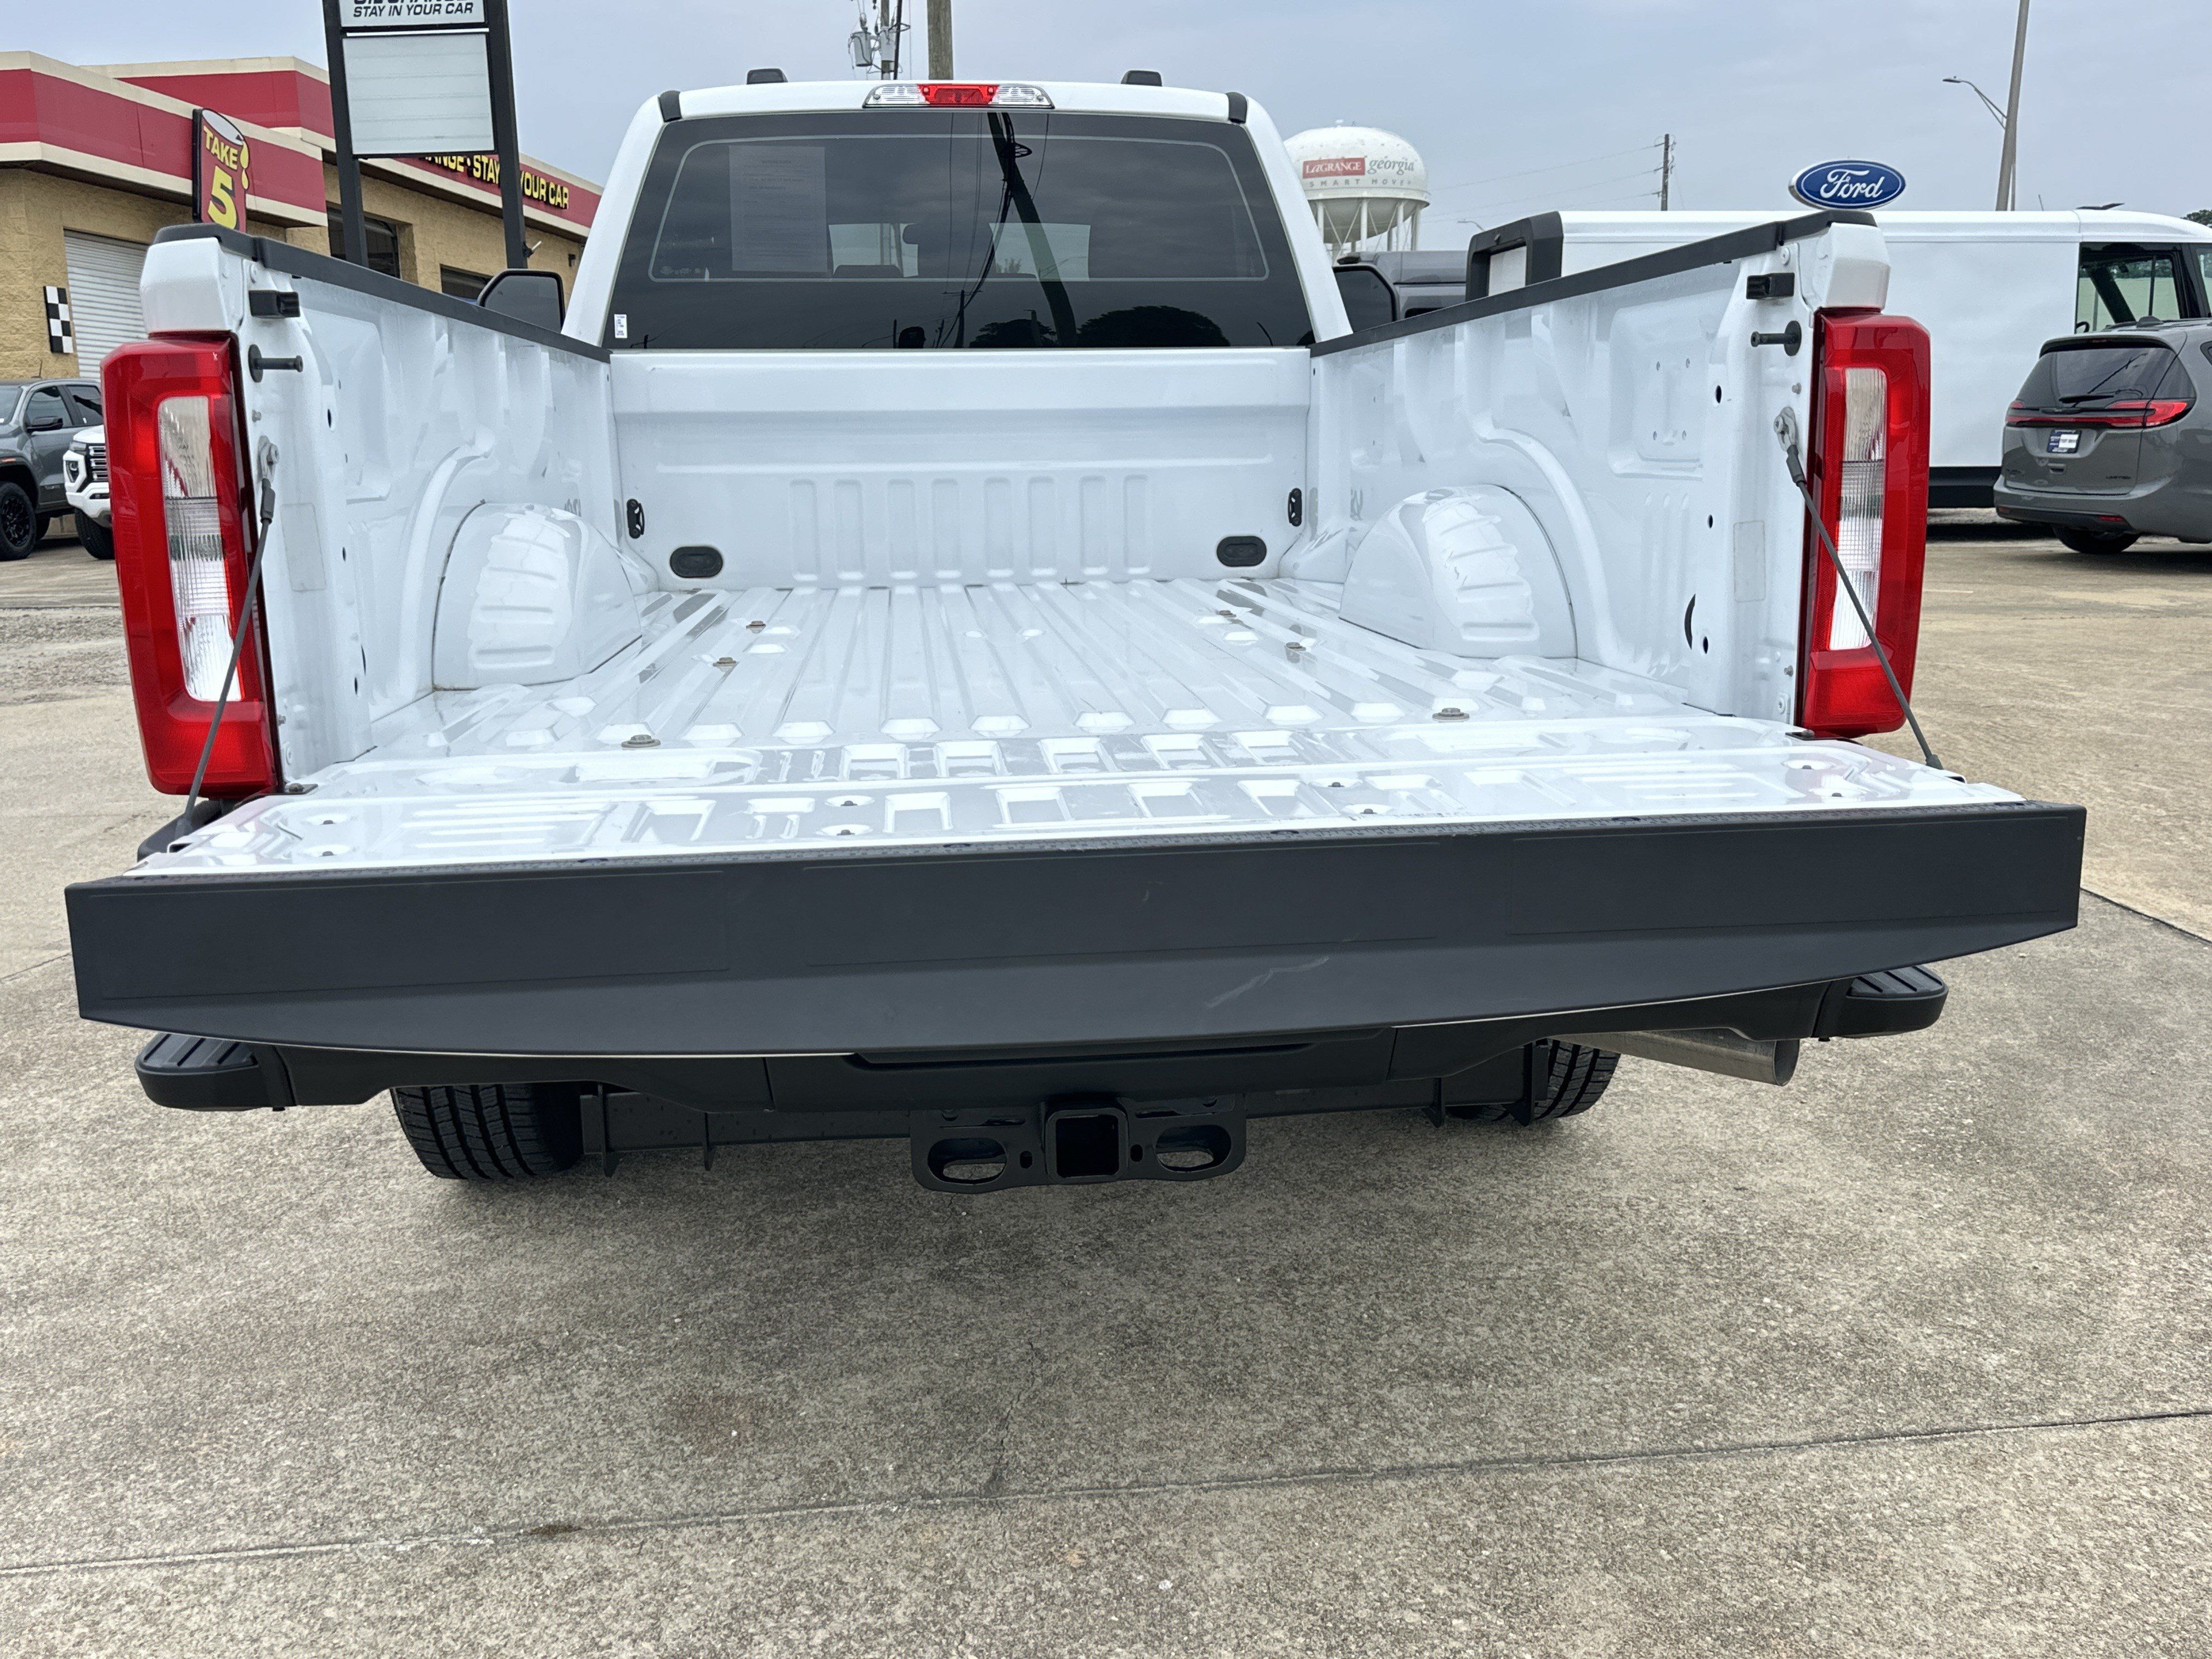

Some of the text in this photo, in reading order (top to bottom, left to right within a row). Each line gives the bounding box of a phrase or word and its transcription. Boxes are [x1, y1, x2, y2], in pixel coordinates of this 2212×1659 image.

[353, 3, 473, 17] STAY IN YOUR CAR
[204, 126, 238, 170] TAKE
[473, 155, 500, 184] STAY
[549, 182, 569, 209] CAR
[1367, 159, 1414, 176] georgia
[208, 165, 237, 229] 5
[1310, 178, 1360, 187] SMART
[1820, 169, 1885, 198] Ford
